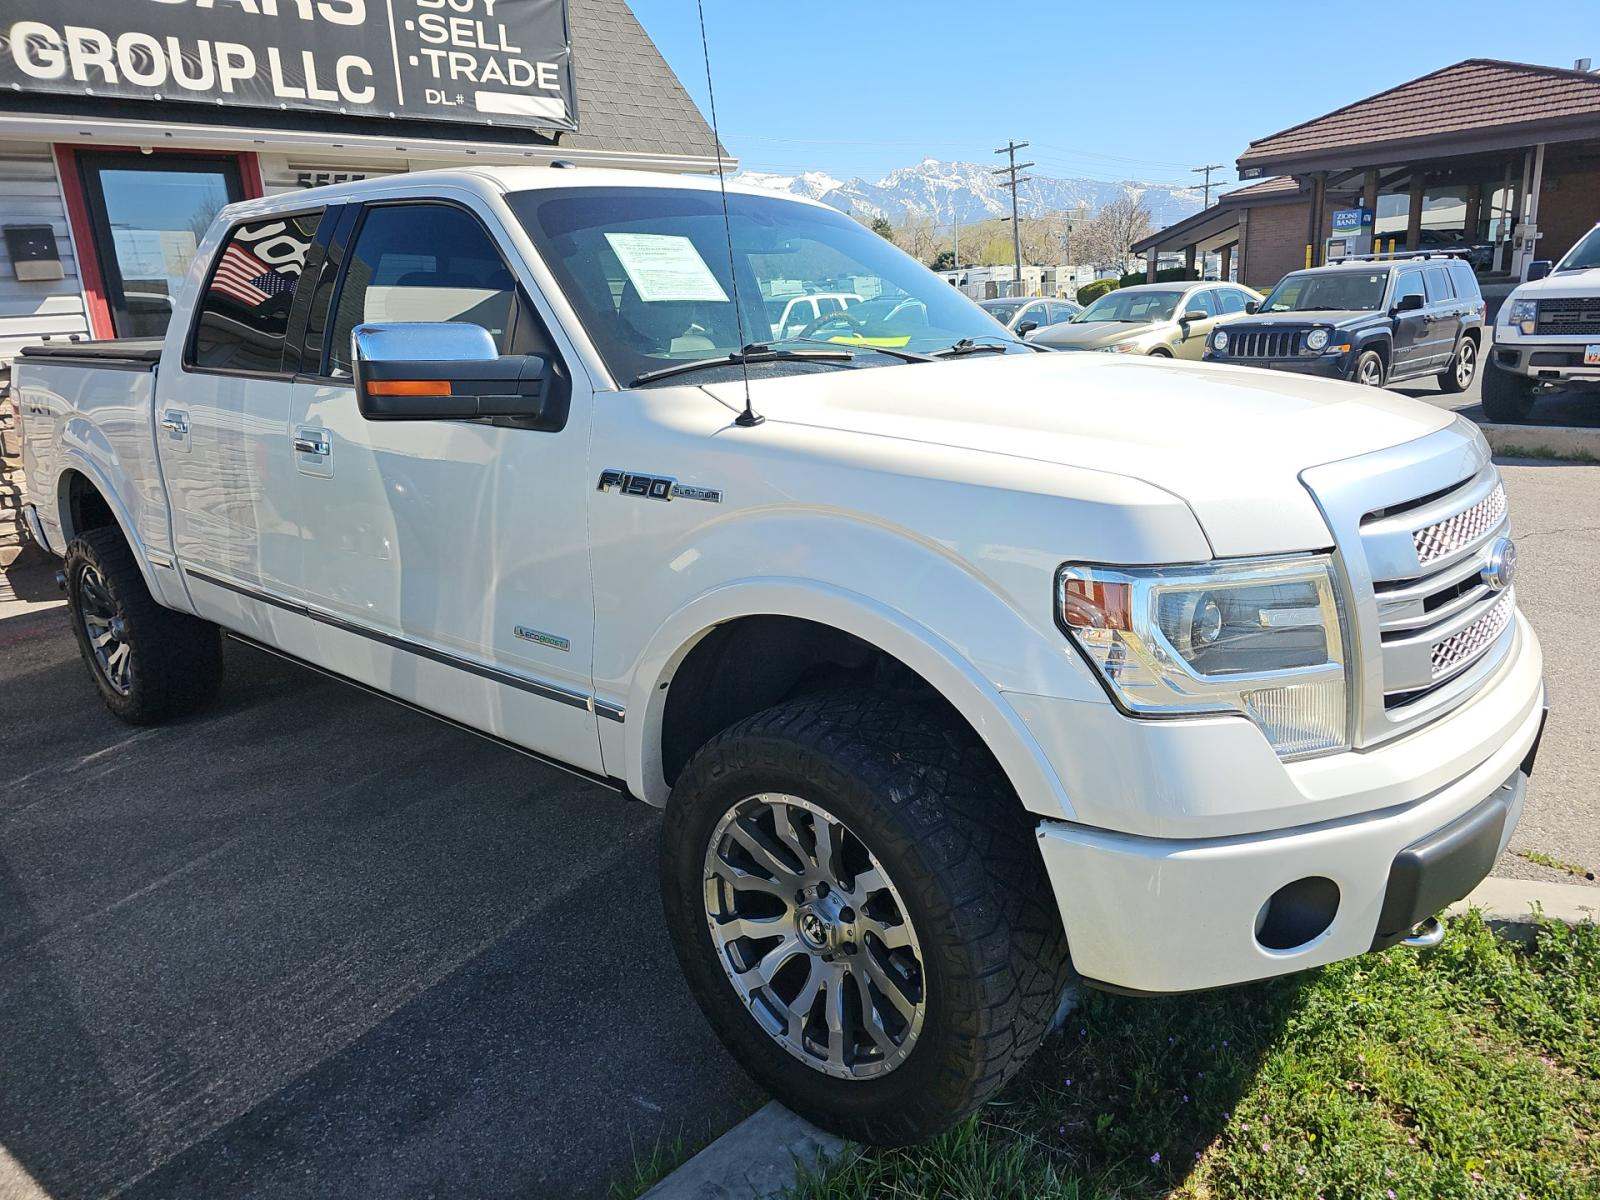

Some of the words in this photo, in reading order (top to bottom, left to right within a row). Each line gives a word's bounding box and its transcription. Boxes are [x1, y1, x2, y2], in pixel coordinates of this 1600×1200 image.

[418, 13, 521, 54] SELL
[9, 20, 257, 94] GROUP
[267, 46, 376, 104] LLC
[420, 48, 561, 91] TRADE
[297, 173, 365, 188] 55
